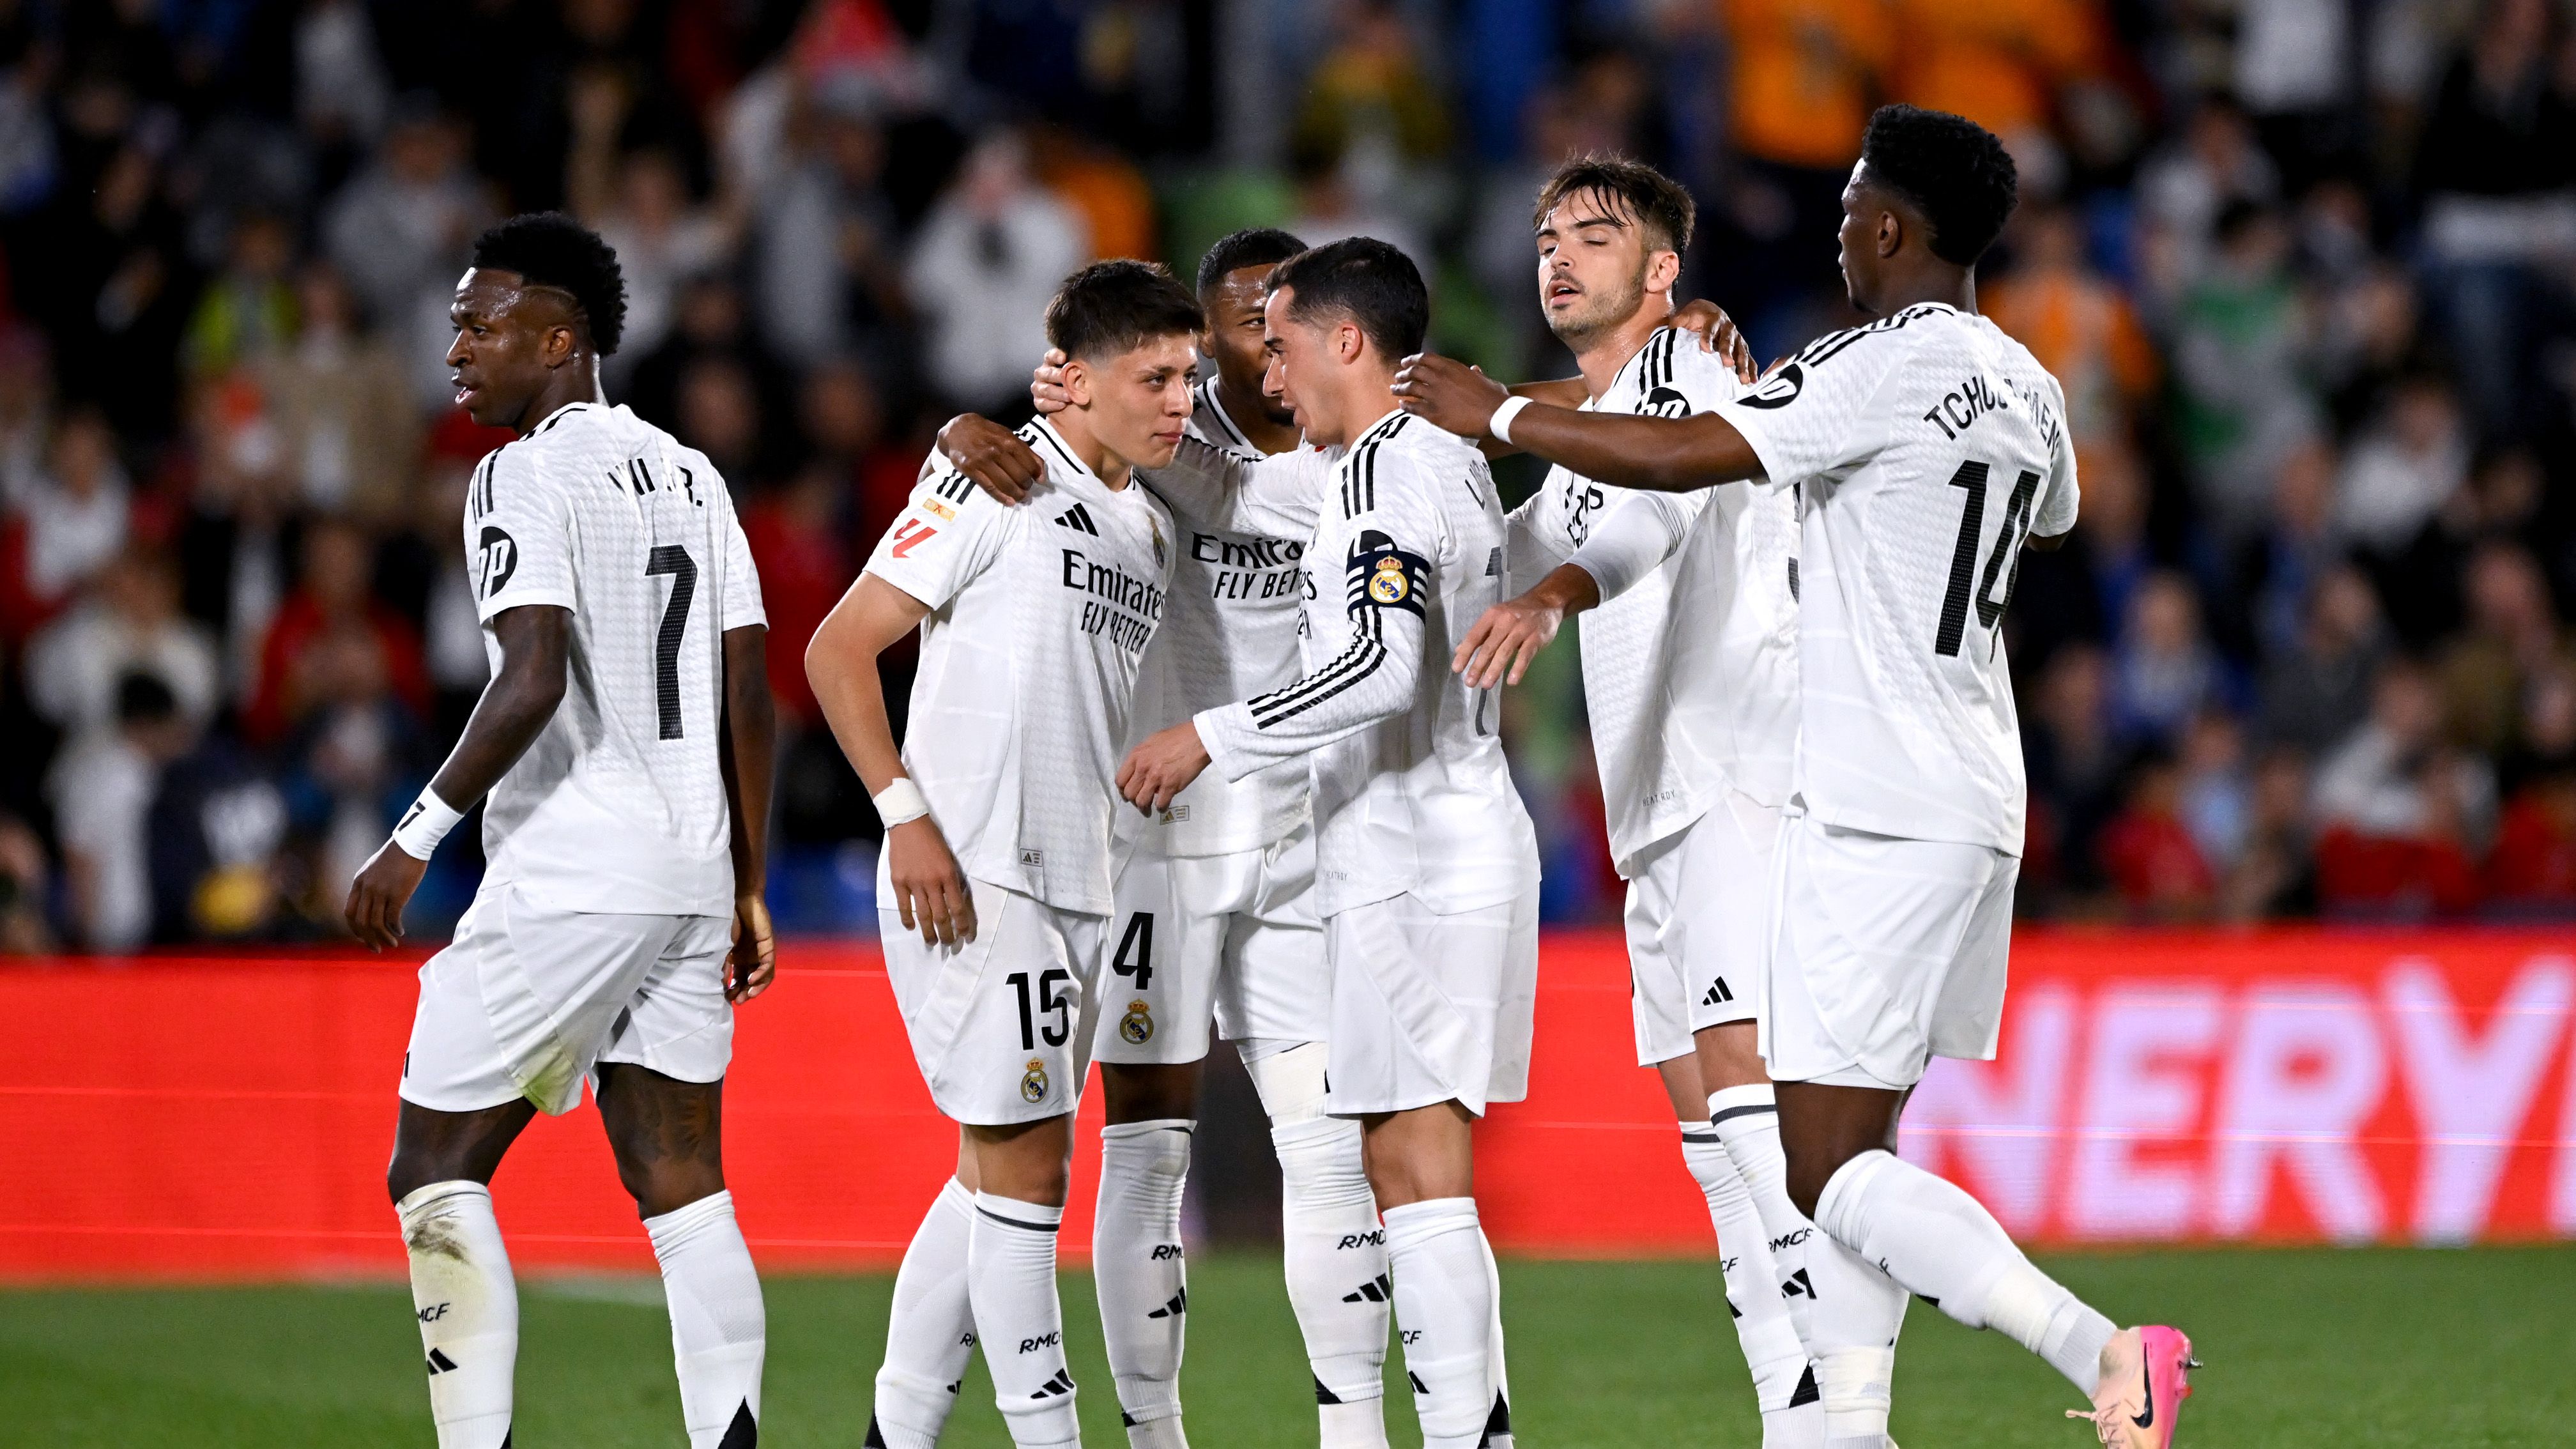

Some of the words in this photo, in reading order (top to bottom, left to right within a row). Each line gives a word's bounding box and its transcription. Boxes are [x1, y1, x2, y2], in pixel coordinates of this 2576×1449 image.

[1192, 531, 1307, 569] Emira
[1935, 459, 2041, 664] 14
[1214, 571, 1257, 599] FLY
[1261, 567, 1300, 599] BET
[645, 544, 698, 740] 7
[1081, 601, 1110, 636] FLY
[1110, 611, 1151, 656] BETTER
[397, 801, 426, 832] 7
[1112, 912, 1154, 990] 4
[1005, 969, 1071, 1051] 15
[1896, 955, 2576, 1246] NERY
[1151, 1244, 1183, 1261] RM
[1337, 1229, 1386, 1250] RMC
[1019, 1331, 1061, 1354] RMC
